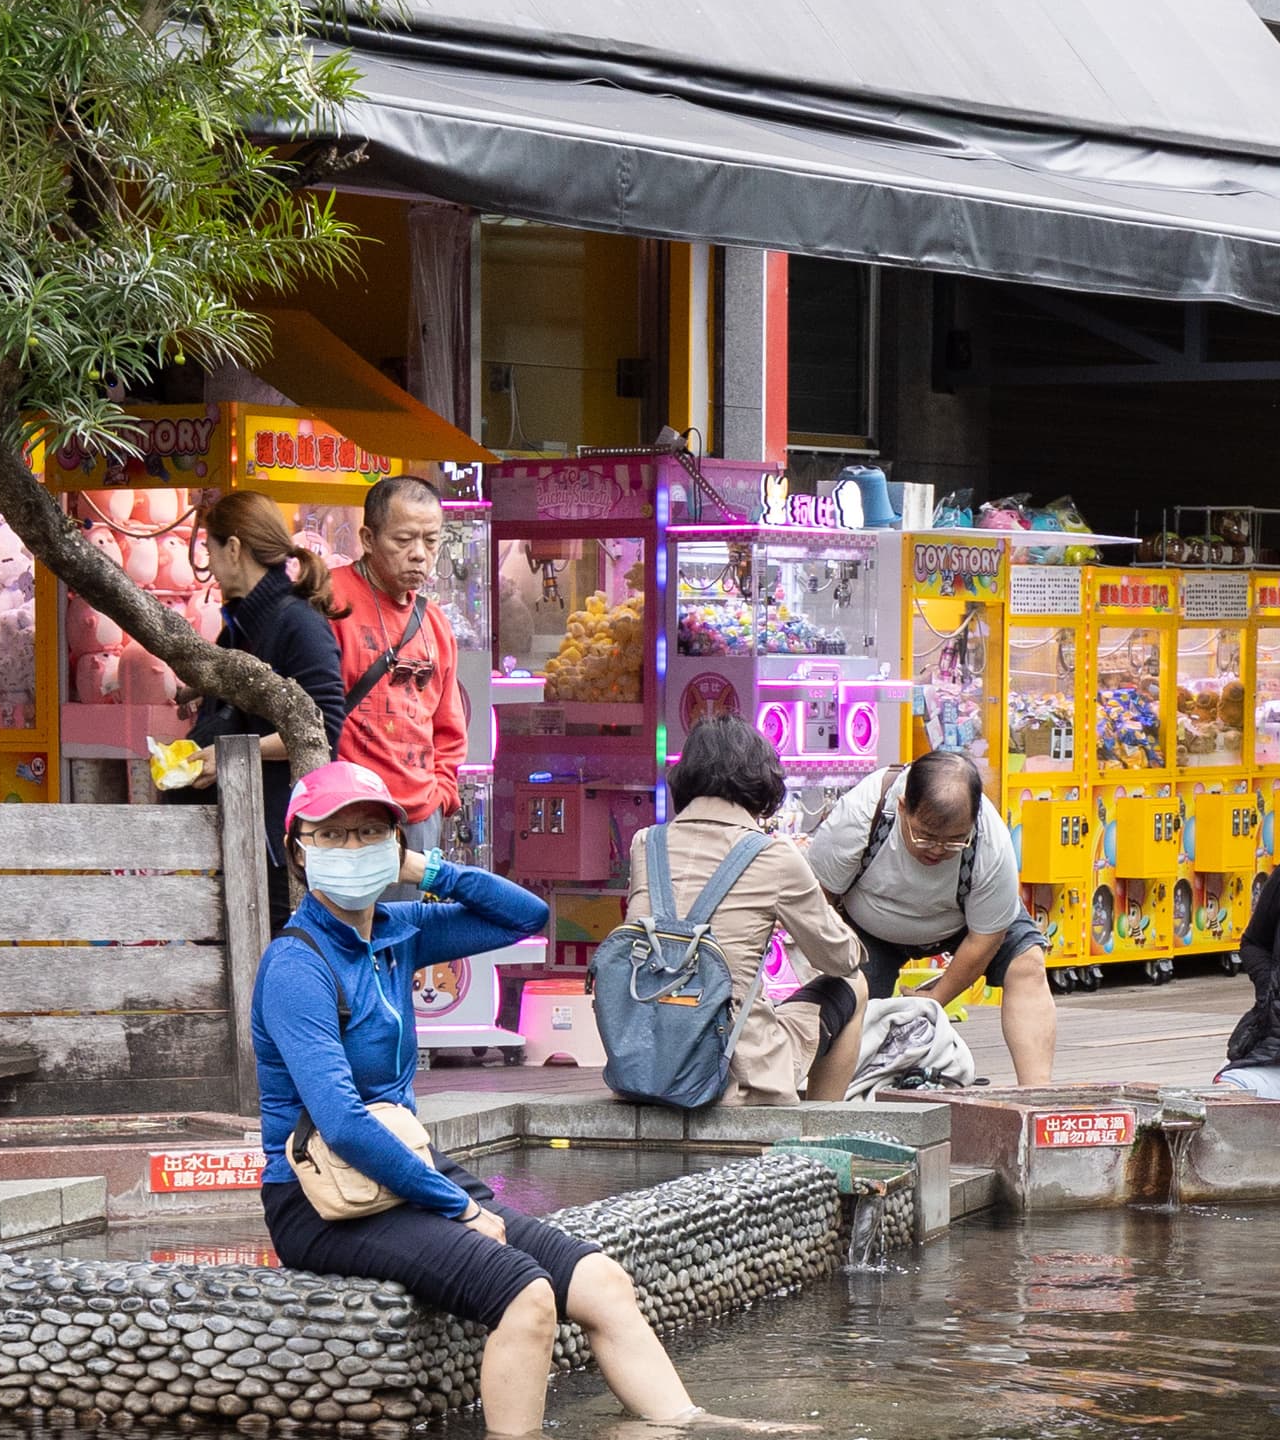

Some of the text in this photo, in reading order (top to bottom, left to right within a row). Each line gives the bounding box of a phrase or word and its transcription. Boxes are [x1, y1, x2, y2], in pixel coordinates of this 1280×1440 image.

[914, 544, 1001, 579] TOY STORY
[1046, 1116, 1126, 1131] 出水口高溫
